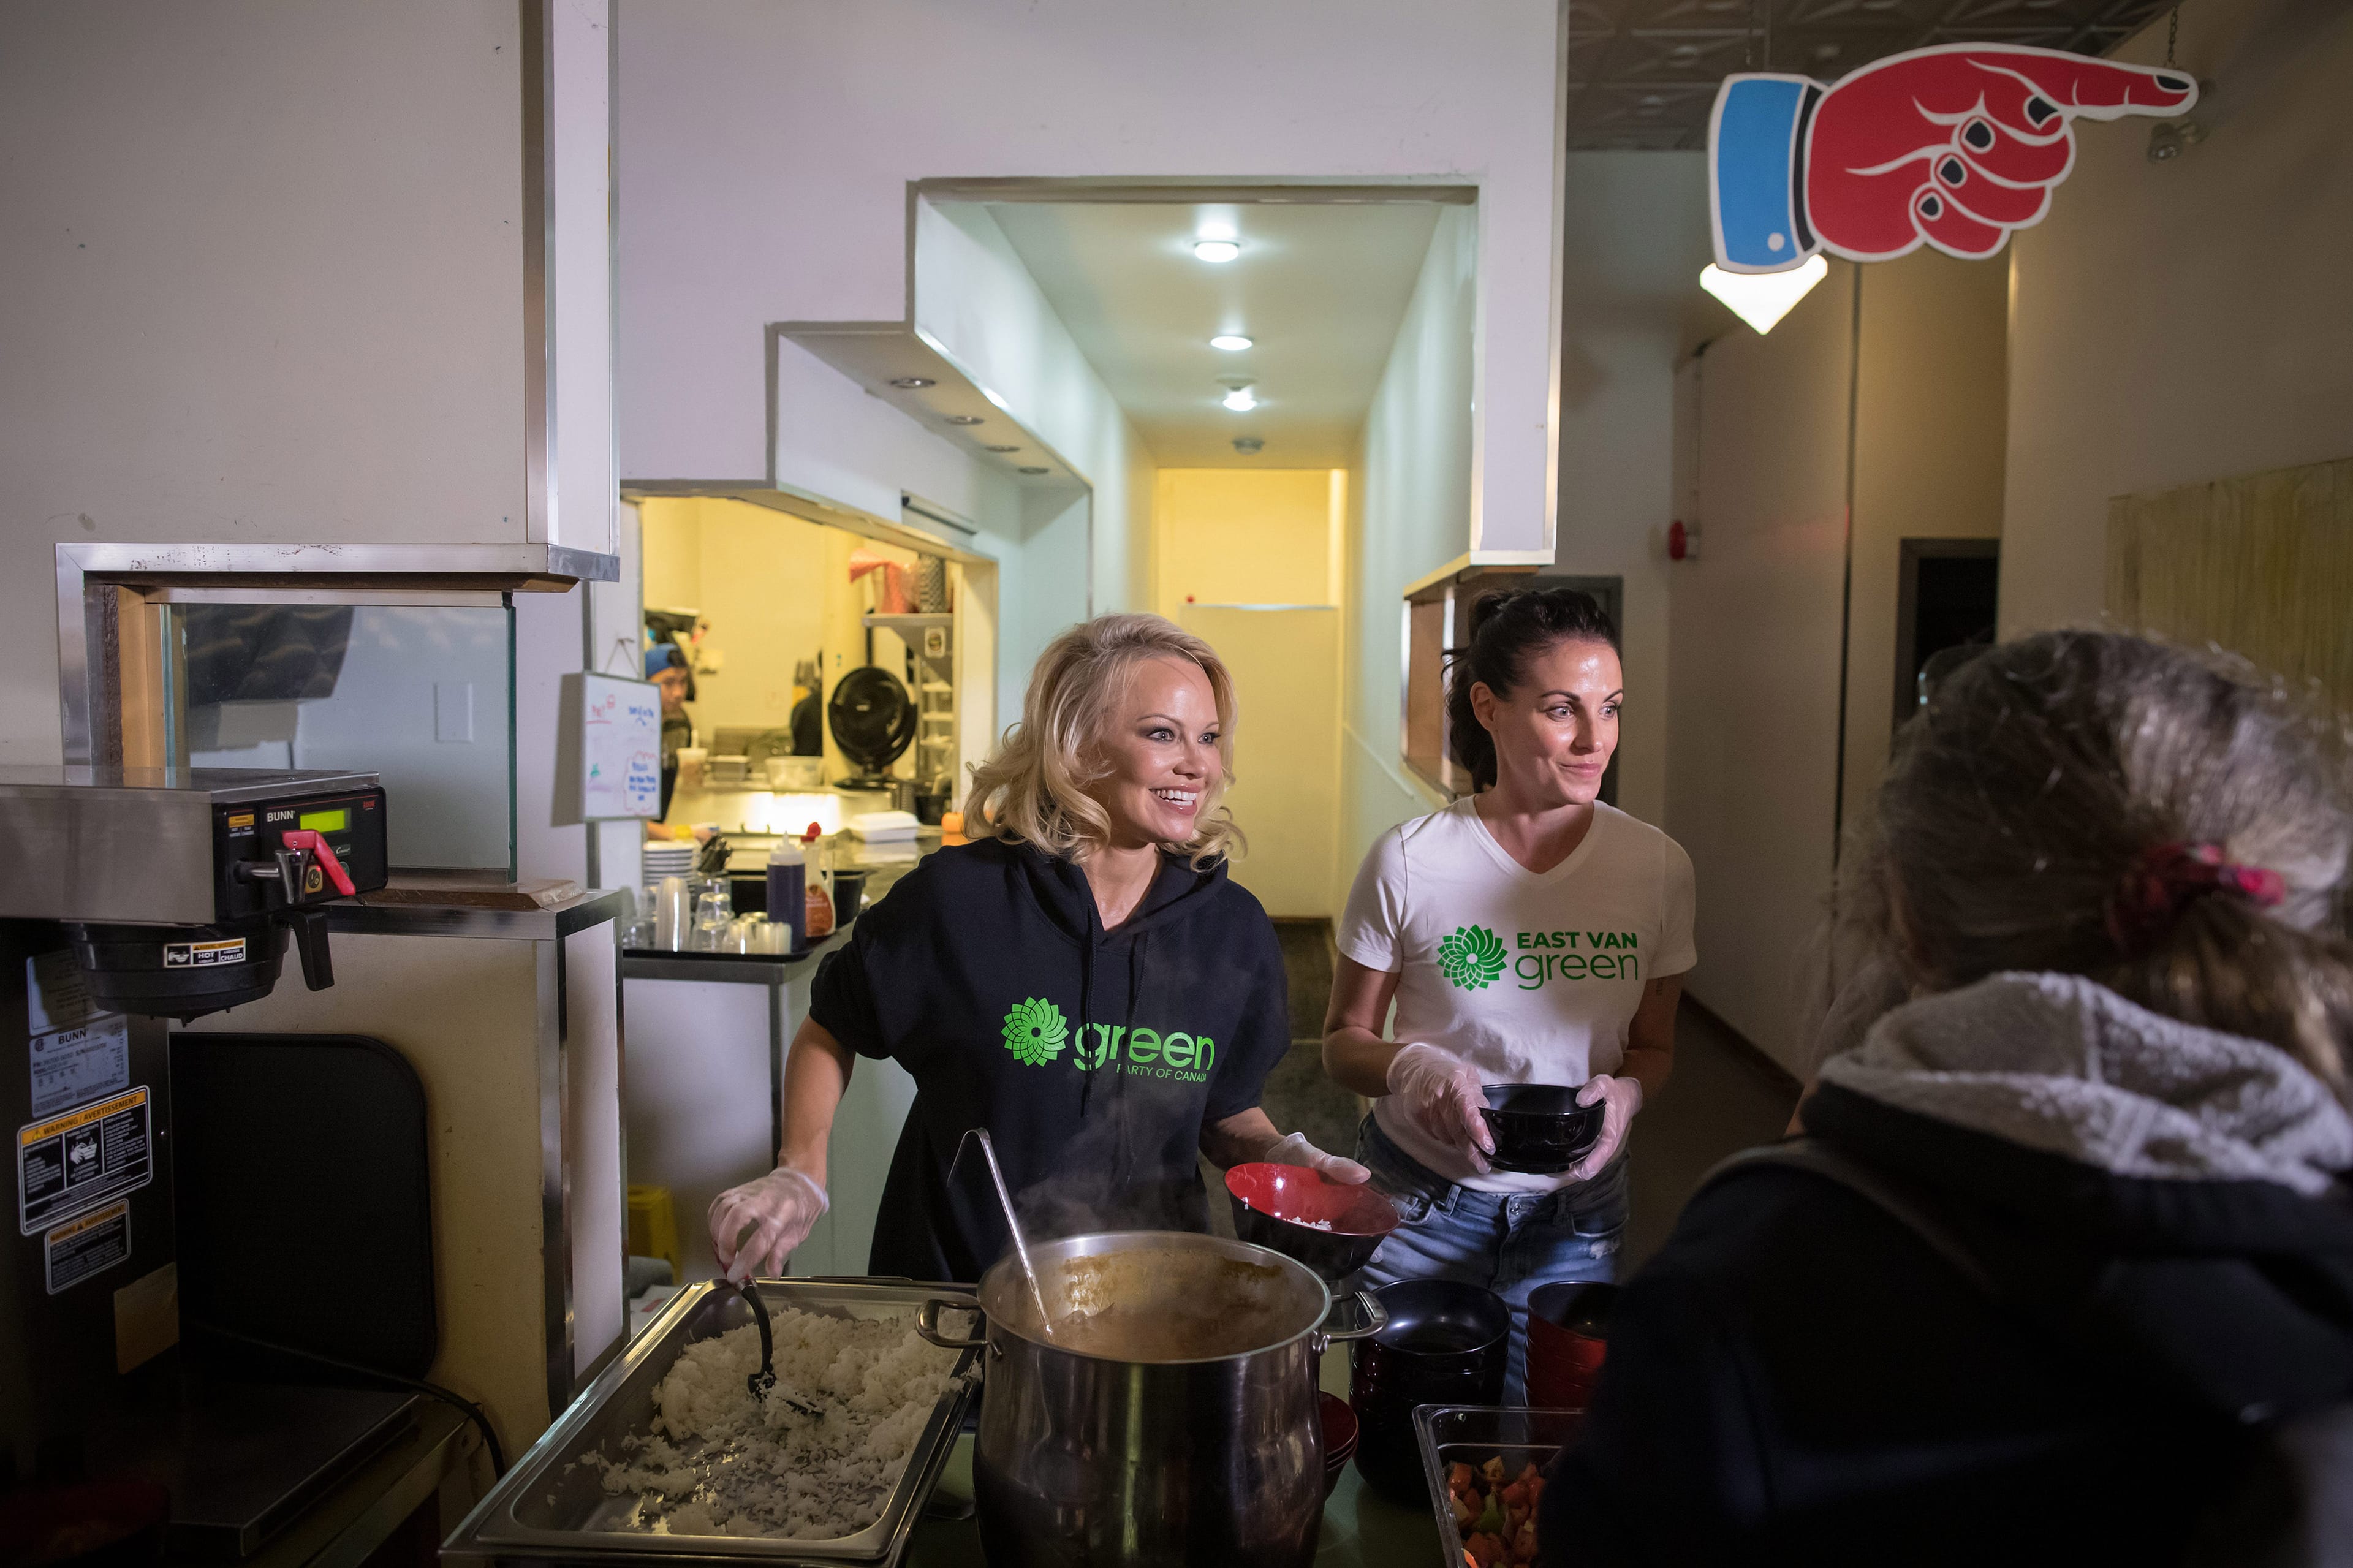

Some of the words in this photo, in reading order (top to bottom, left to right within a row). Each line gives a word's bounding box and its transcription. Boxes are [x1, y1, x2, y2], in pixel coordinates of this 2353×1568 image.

[267, 810, 294, 822] BUNN
[1517, 931, 1580, 949] EAST
[1586, 931, 1638, 949] VAN
[1515, 954, 1638, 990] green
[58, 1029, 87, 1044] BUNN
[1074, 1023, 1215, 1071] green
[1156, 1068, 1172, 1078] OF
[43, 1116, 78, 1135] WARNING
[83, 1096, 138, 1121] AVERTISSEMENT
